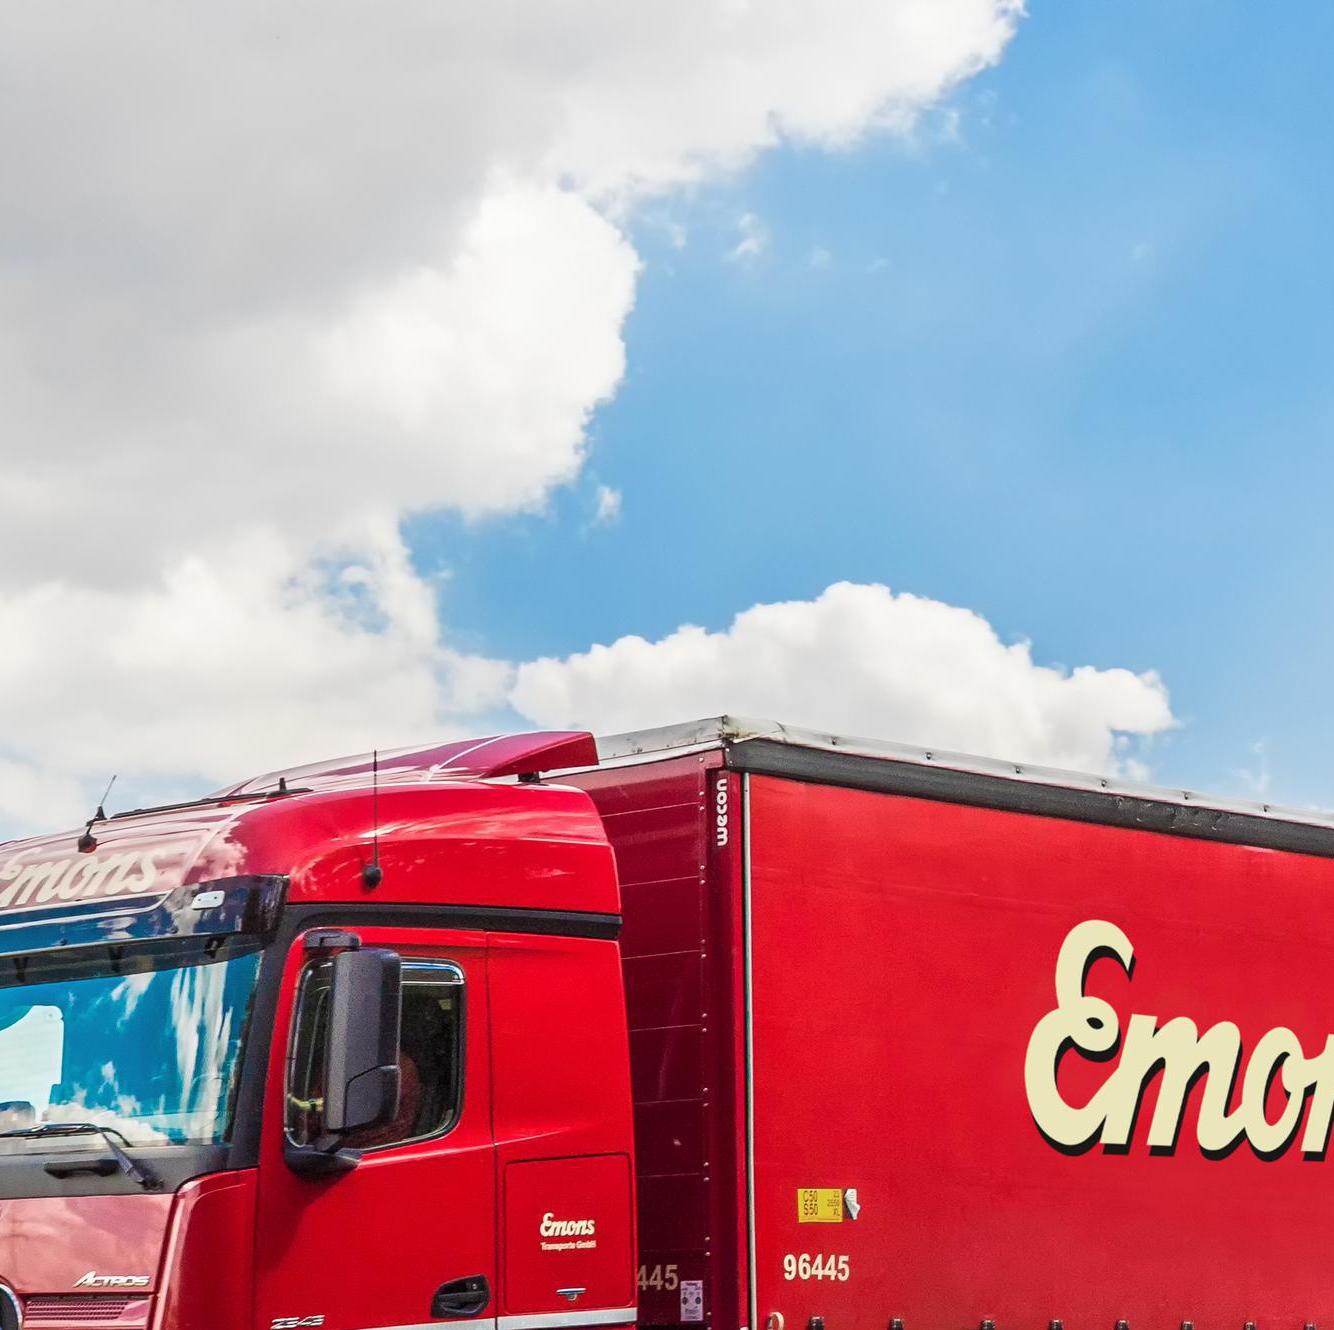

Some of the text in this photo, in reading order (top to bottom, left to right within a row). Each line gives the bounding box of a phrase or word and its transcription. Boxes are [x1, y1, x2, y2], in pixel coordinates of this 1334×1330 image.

[716, 778, 728, 847] wecon
[540, 1212, 596, 1237] Emons
[783, 1253, 850, 1281] 96445
